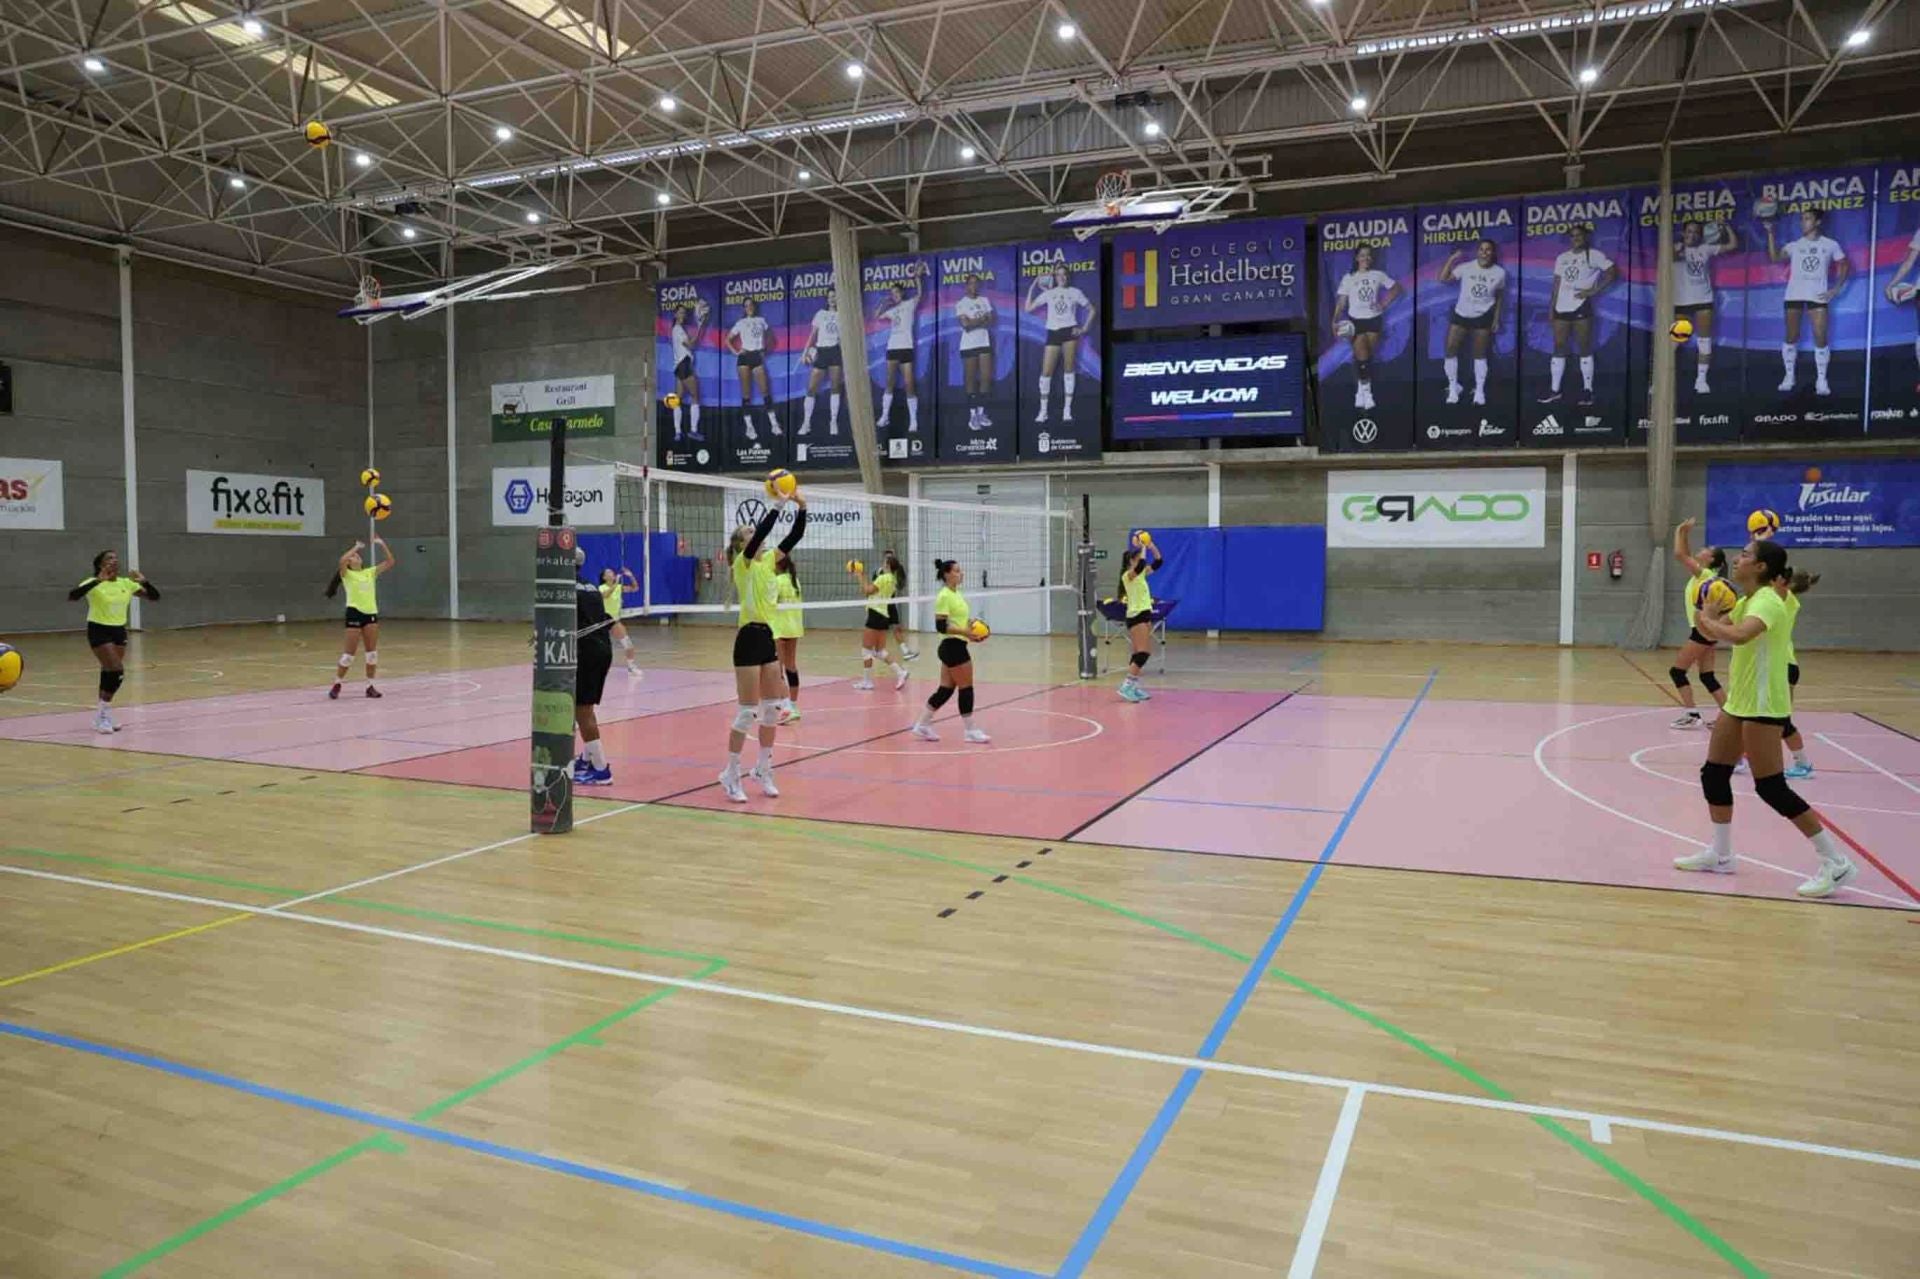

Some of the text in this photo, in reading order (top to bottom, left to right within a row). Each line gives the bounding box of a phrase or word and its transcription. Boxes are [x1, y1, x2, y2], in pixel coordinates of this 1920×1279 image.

[1763, 176, 1866, 202] BLANCA
[1527, 199, 1623, 224] DAYANA
[1641, 187, 1736, 215] MREIA
[1323, 217, 1409, 240] CLAUDIA
[1423, 208, 1512, 231] CAMILA
[1423, 229, 1480, 244] HIRUELA
[1022, 248, 1065, 266] LOLA
[1170, 237, 1295, 259] COLEGIO
[943, 256, 984, 274] WIN
[1170, 258, 1295, 287] Heidelberg
[661, 282, 698, 302] SOFÍA
[725, 276, 785, 295] CANDELA
[1170, 288, 1294, 305] GRAN CANARIA
[1123, 355, 1289, 377] BIENVENIDAS
[1151, 387, 1259, 406] WELKOM
[210, 476, 305, 518] fix&fit
